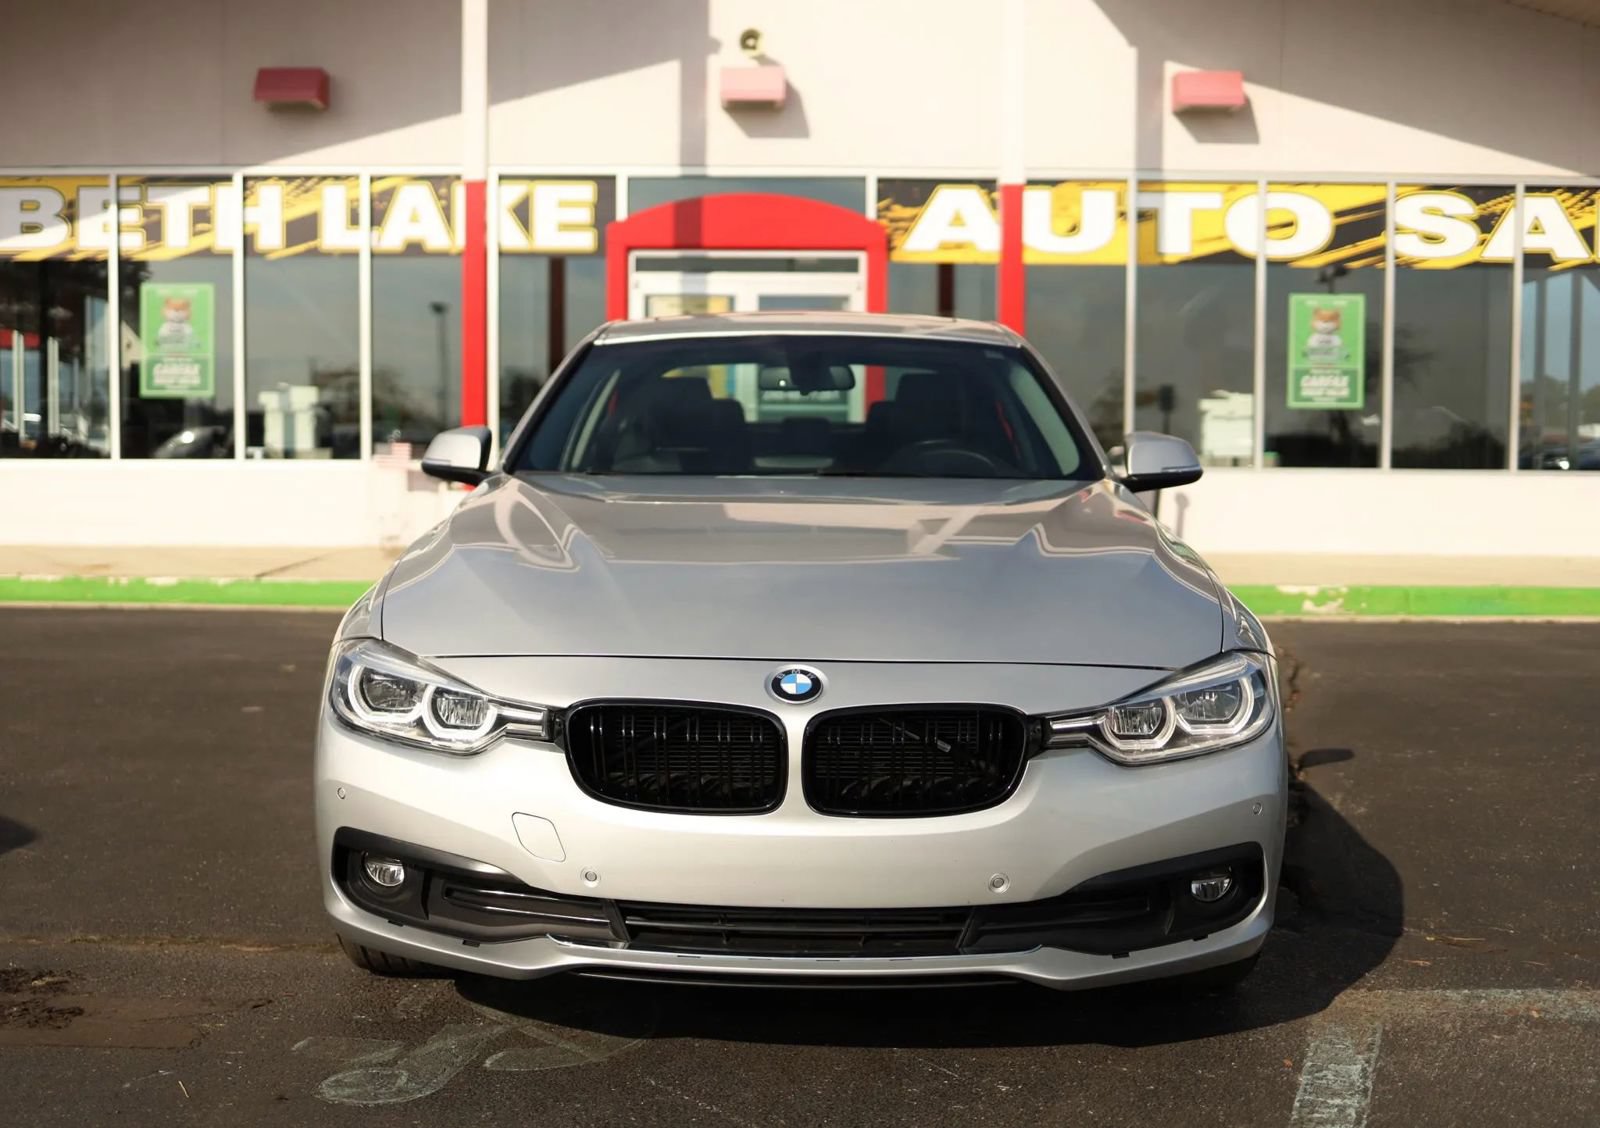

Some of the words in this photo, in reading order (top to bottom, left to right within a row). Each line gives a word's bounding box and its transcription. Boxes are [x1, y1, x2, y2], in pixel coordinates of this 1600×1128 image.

[0, 184, 284, 251] BETH
[319, 182, 597, 252] LAKE
[900, 187, 1334, 258] AUTO
[1391, 191, 1600, 260] SA
